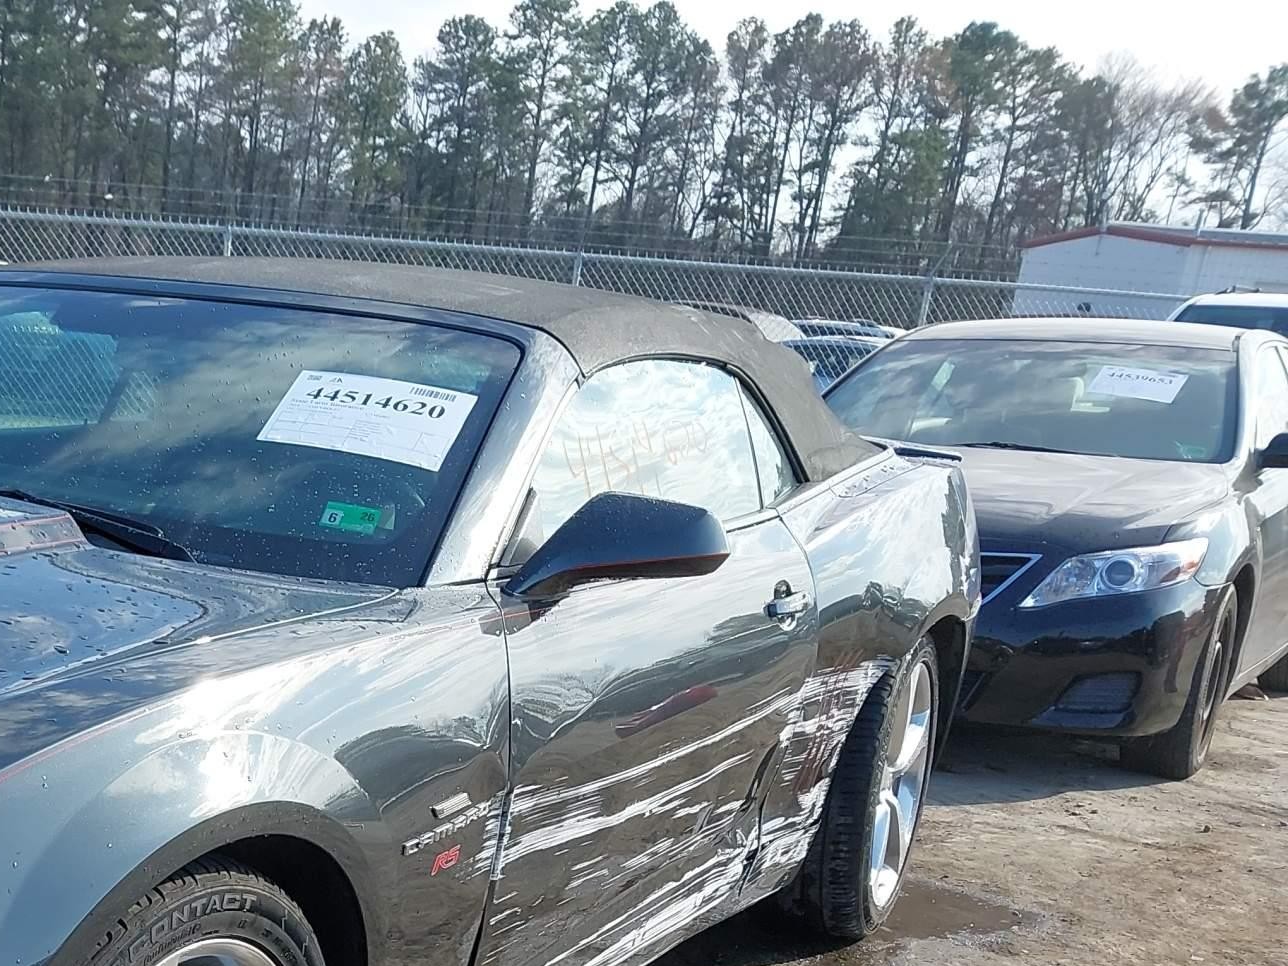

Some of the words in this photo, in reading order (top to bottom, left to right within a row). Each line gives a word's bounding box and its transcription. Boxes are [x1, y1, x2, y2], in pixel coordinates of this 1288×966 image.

[306, 387, 445, 419] 44514620
[328, 512, 338, 523] 6
[360, 511, 376, 522] 26
[431, 845, 461, 876] RS
